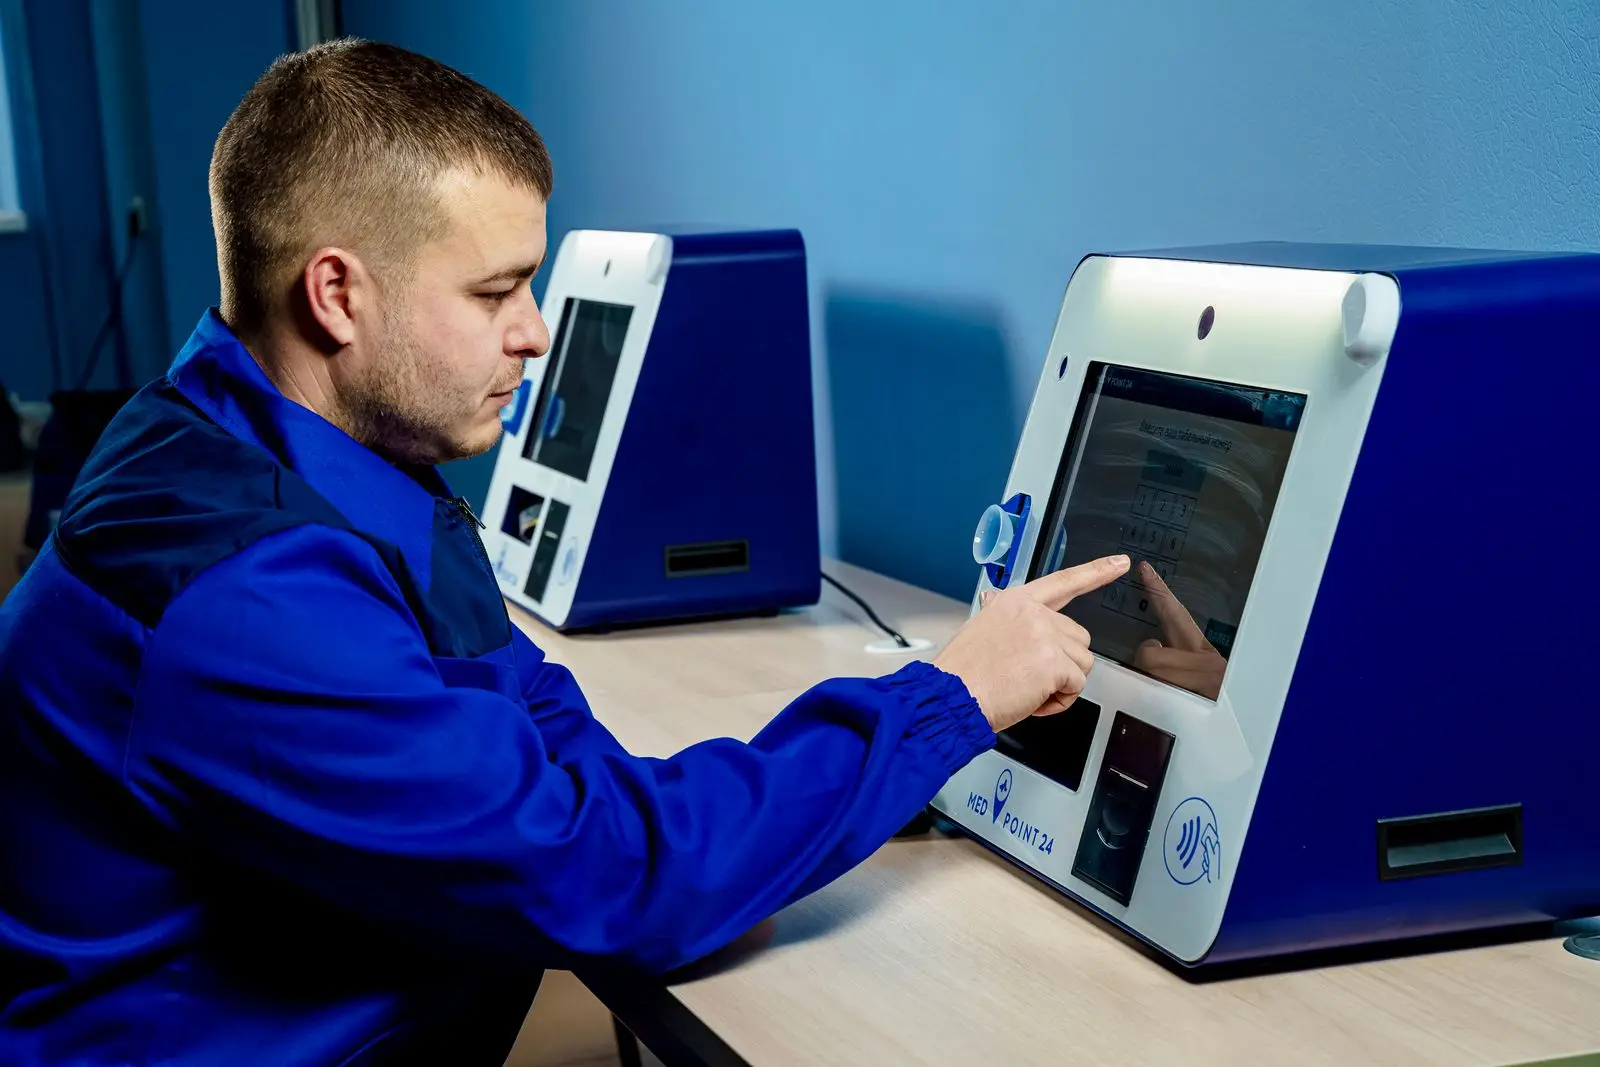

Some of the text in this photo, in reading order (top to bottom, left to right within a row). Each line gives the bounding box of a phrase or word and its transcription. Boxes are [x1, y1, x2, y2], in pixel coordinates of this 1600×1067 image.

[967, 792, 1055, 856] MED POINT 24
